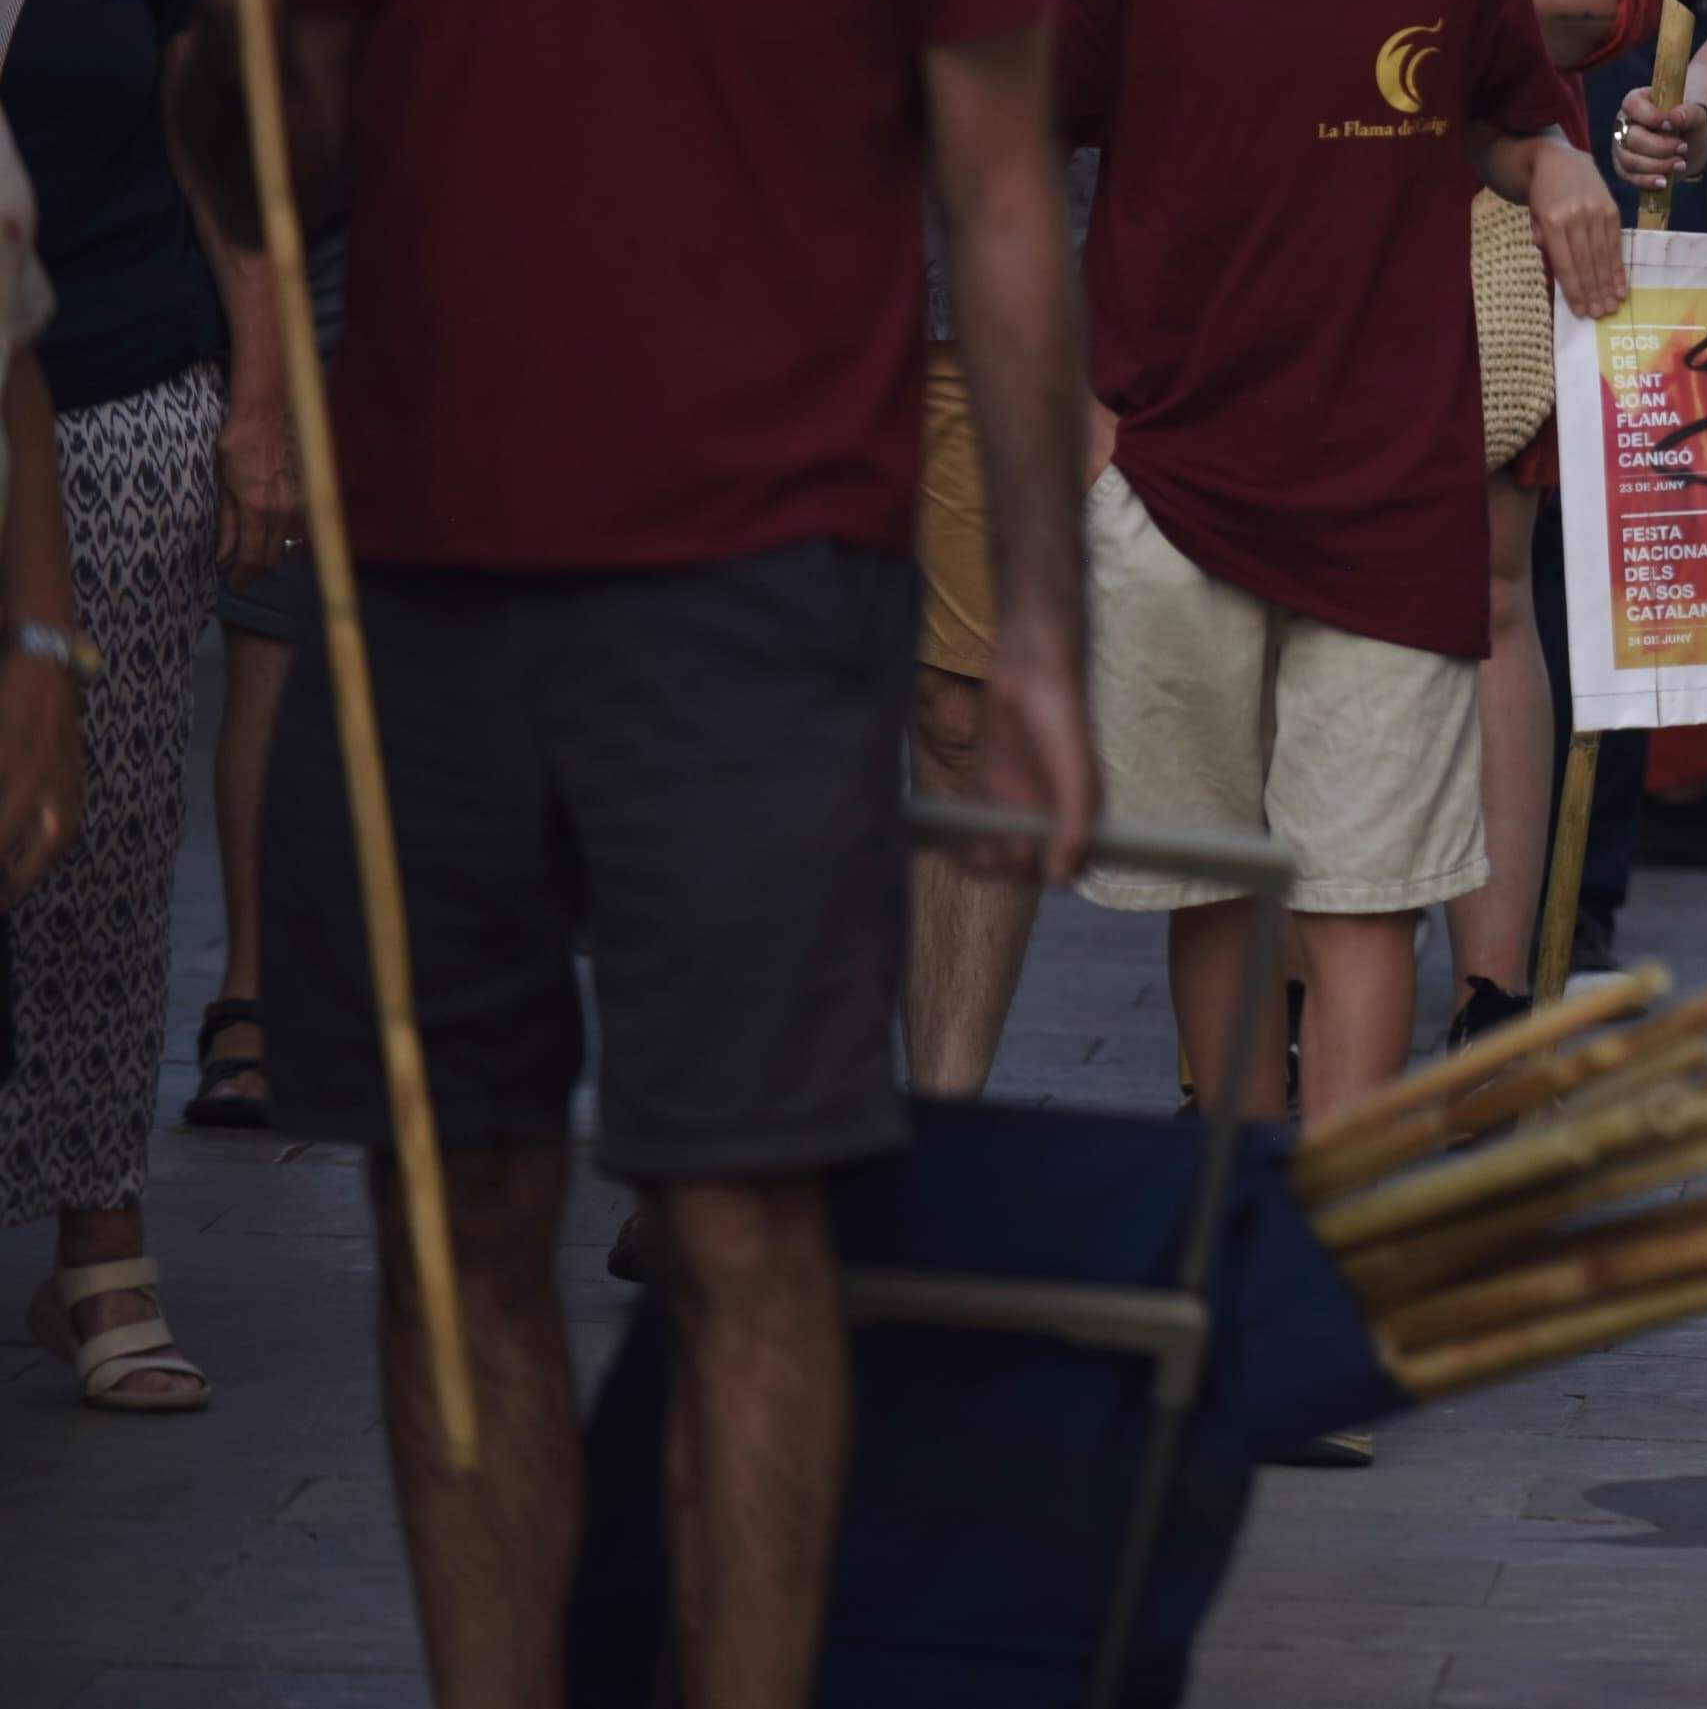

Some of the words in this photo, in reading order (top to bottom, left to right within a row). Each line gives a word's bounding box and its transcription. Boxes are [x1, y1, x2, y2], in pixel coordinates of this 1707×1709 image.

[1318, 123, 1339, 139] La
[1343, 120, 1394, 137] Flama
[1610, 336, 1660, 351] FOCS
[1612, 355, 1637, 369] DE
[1613, 373, 1662, 389] SANT
[1615, 393, 1665, 408] JOAN
[1617, 412, 1681, 428] FLAMA
[1618, 432, 1655, 448] DEL
[1618, 447, 1693, 467] CANIGÓ
[1619, 482, 1633, 493] 23
[1635, 481, 1650, 492] DE
[1653, 480, 1685, 491] JUNY
[1622, 525, 1683, 542] FESTA
[1625, 565, 1674, 582] DELS
[1625, 582, 1695, 602] PAÏSOS
[1662, 633, 1692, 644] JUNY
